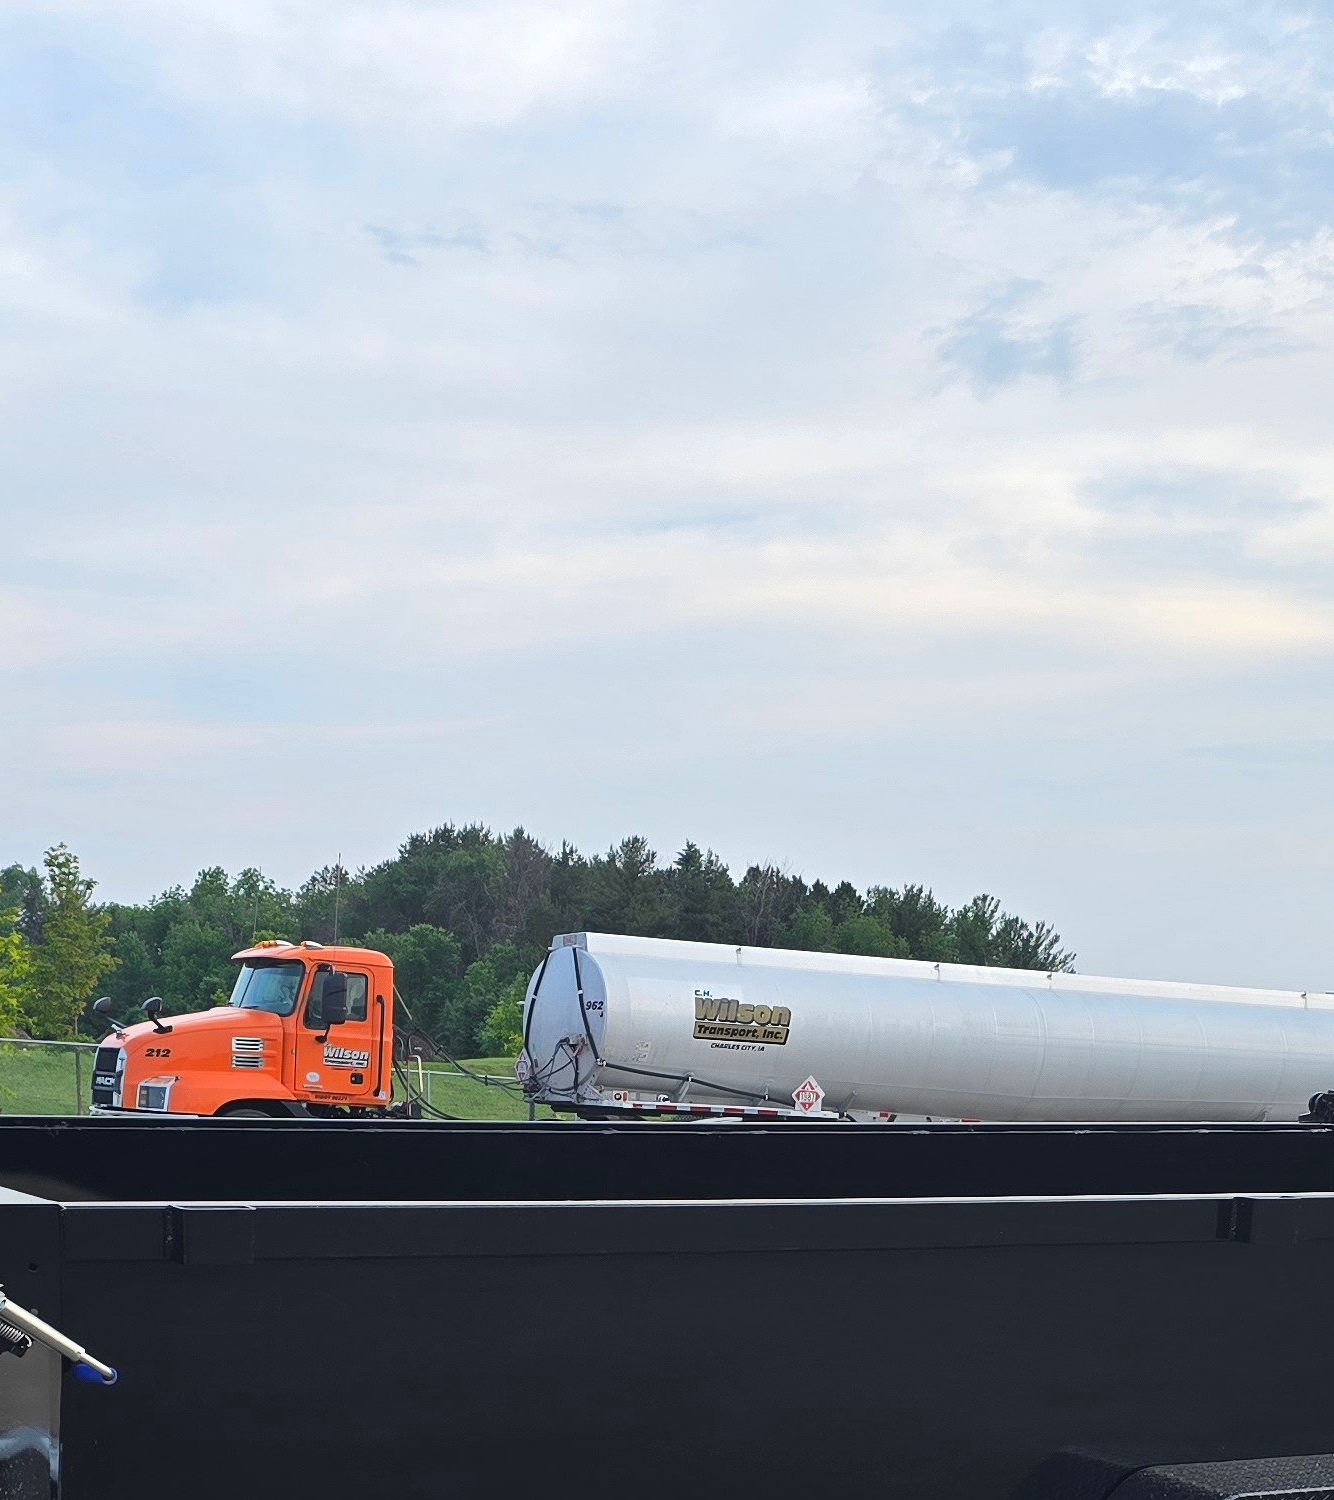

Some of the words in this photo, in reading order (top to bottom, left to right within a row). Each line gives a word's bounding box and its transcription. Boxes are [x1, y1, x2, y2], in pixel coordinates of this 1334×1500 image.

[586, 1001, 604, 1010] 962
[694, 997, 791, 1027] Wilson
[697, 1025, 759, 1039] Transport,
[762, 1030, 783, 1039] Inc.
[145, 1048, 171, 1057] 212
[323, 1046, 369, 1060] Wilson
